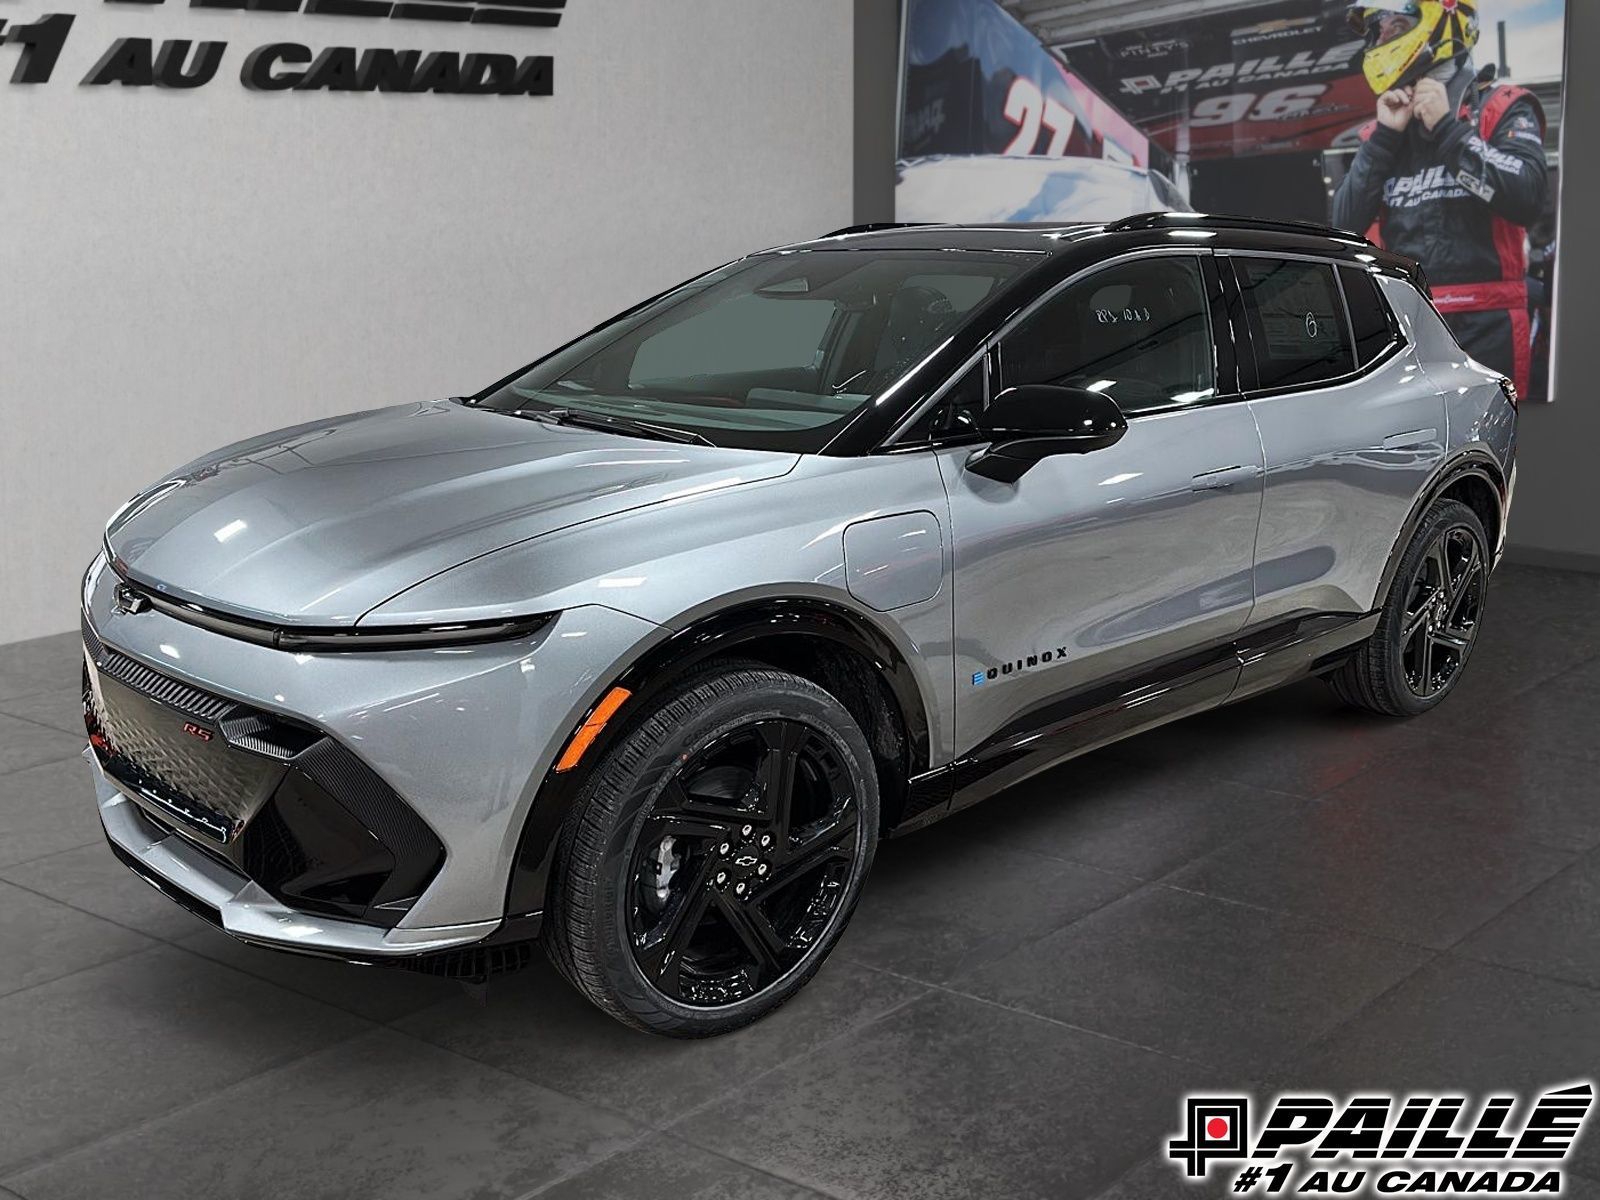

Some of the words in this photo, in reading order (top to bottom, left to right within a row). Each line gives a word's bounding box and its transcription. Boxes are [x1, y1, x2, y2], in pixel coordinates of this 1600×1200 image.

[1231, 26, 1323, 46] CHEVROLET
[79, 37, 228, 89] AU
[240, 42, 554, 97] CANADA
[1238, 62, 1350, 83] CANADA
[1004, 77, 1075, 157] 27
[1190, 84, 1328, 127] 96
[972, 646, 1067, 686] EQUINOX
[183, 722, 213, 743] RS
